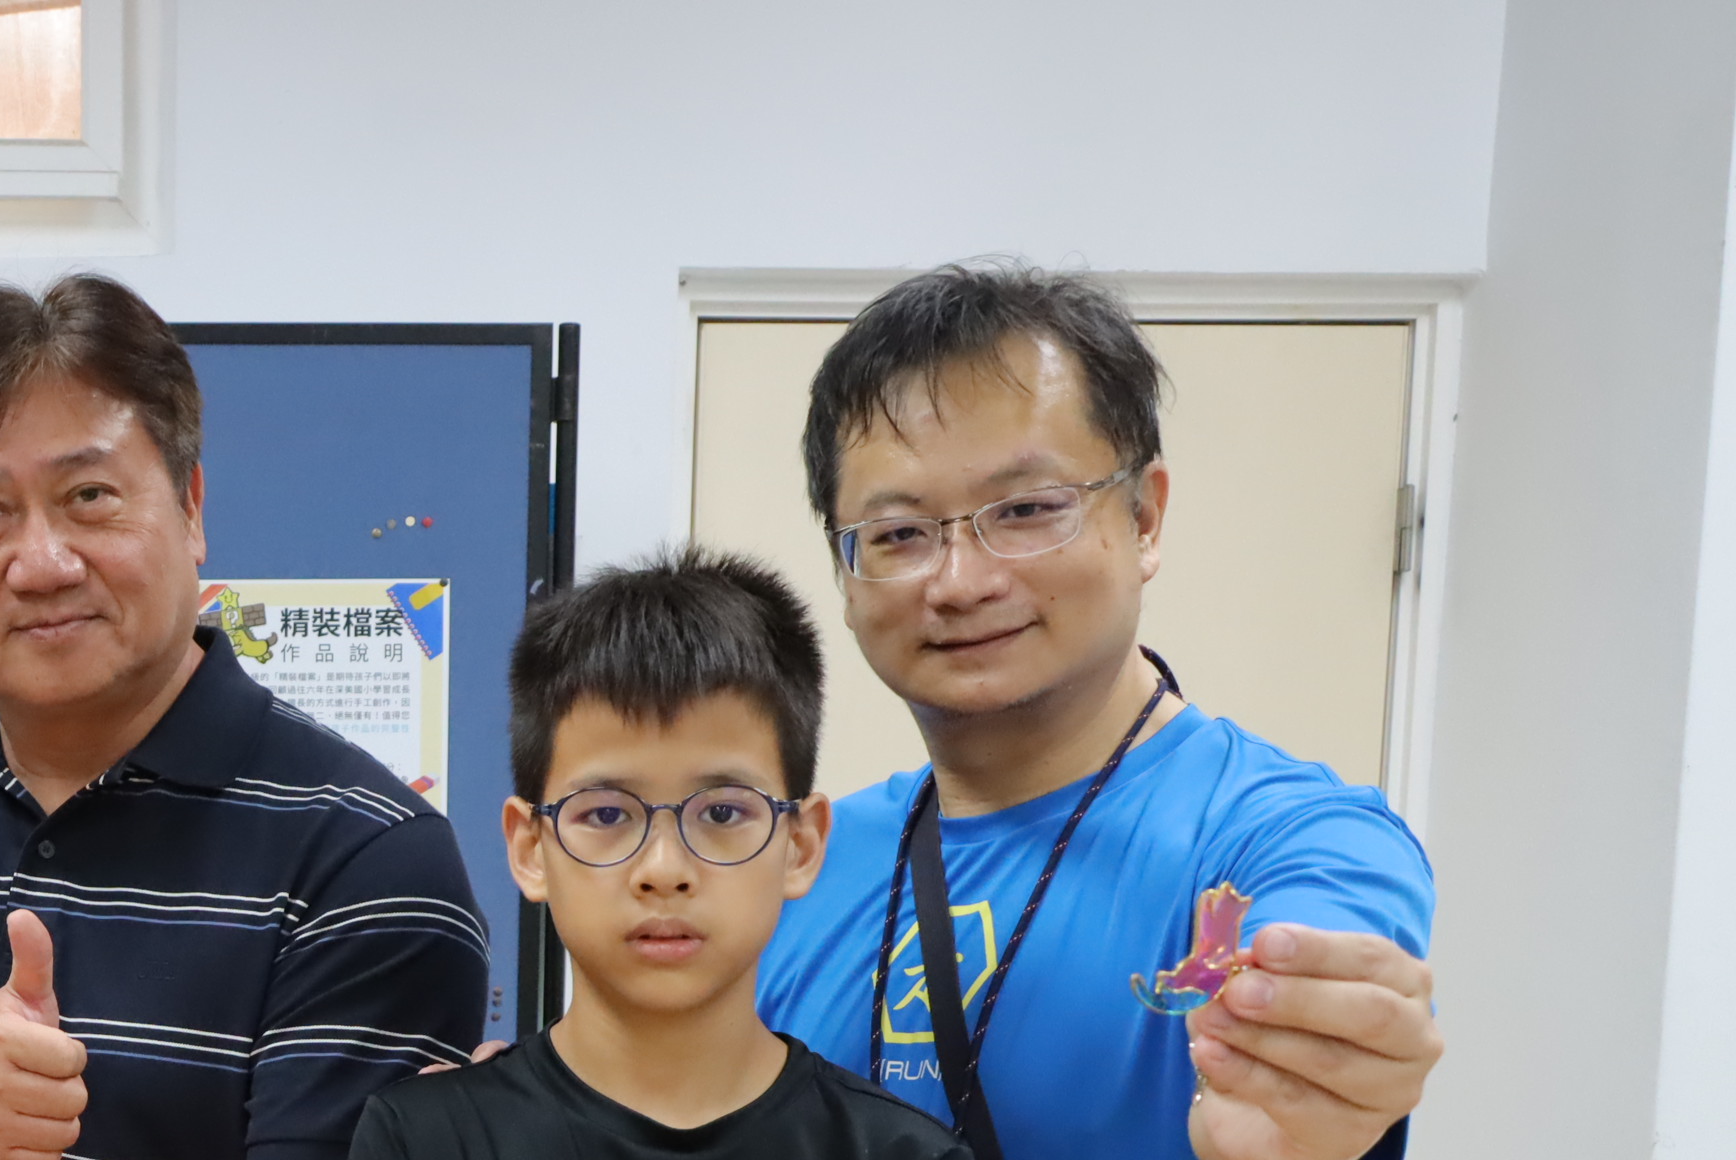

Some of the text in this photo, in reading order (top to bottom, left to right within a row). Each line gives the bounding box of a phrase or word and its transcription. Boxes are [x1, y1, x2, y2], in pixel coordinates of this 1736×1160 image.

[280, 607, 404, 638] 精裝檔案
[280, 643, 404, 663] 作品說明
